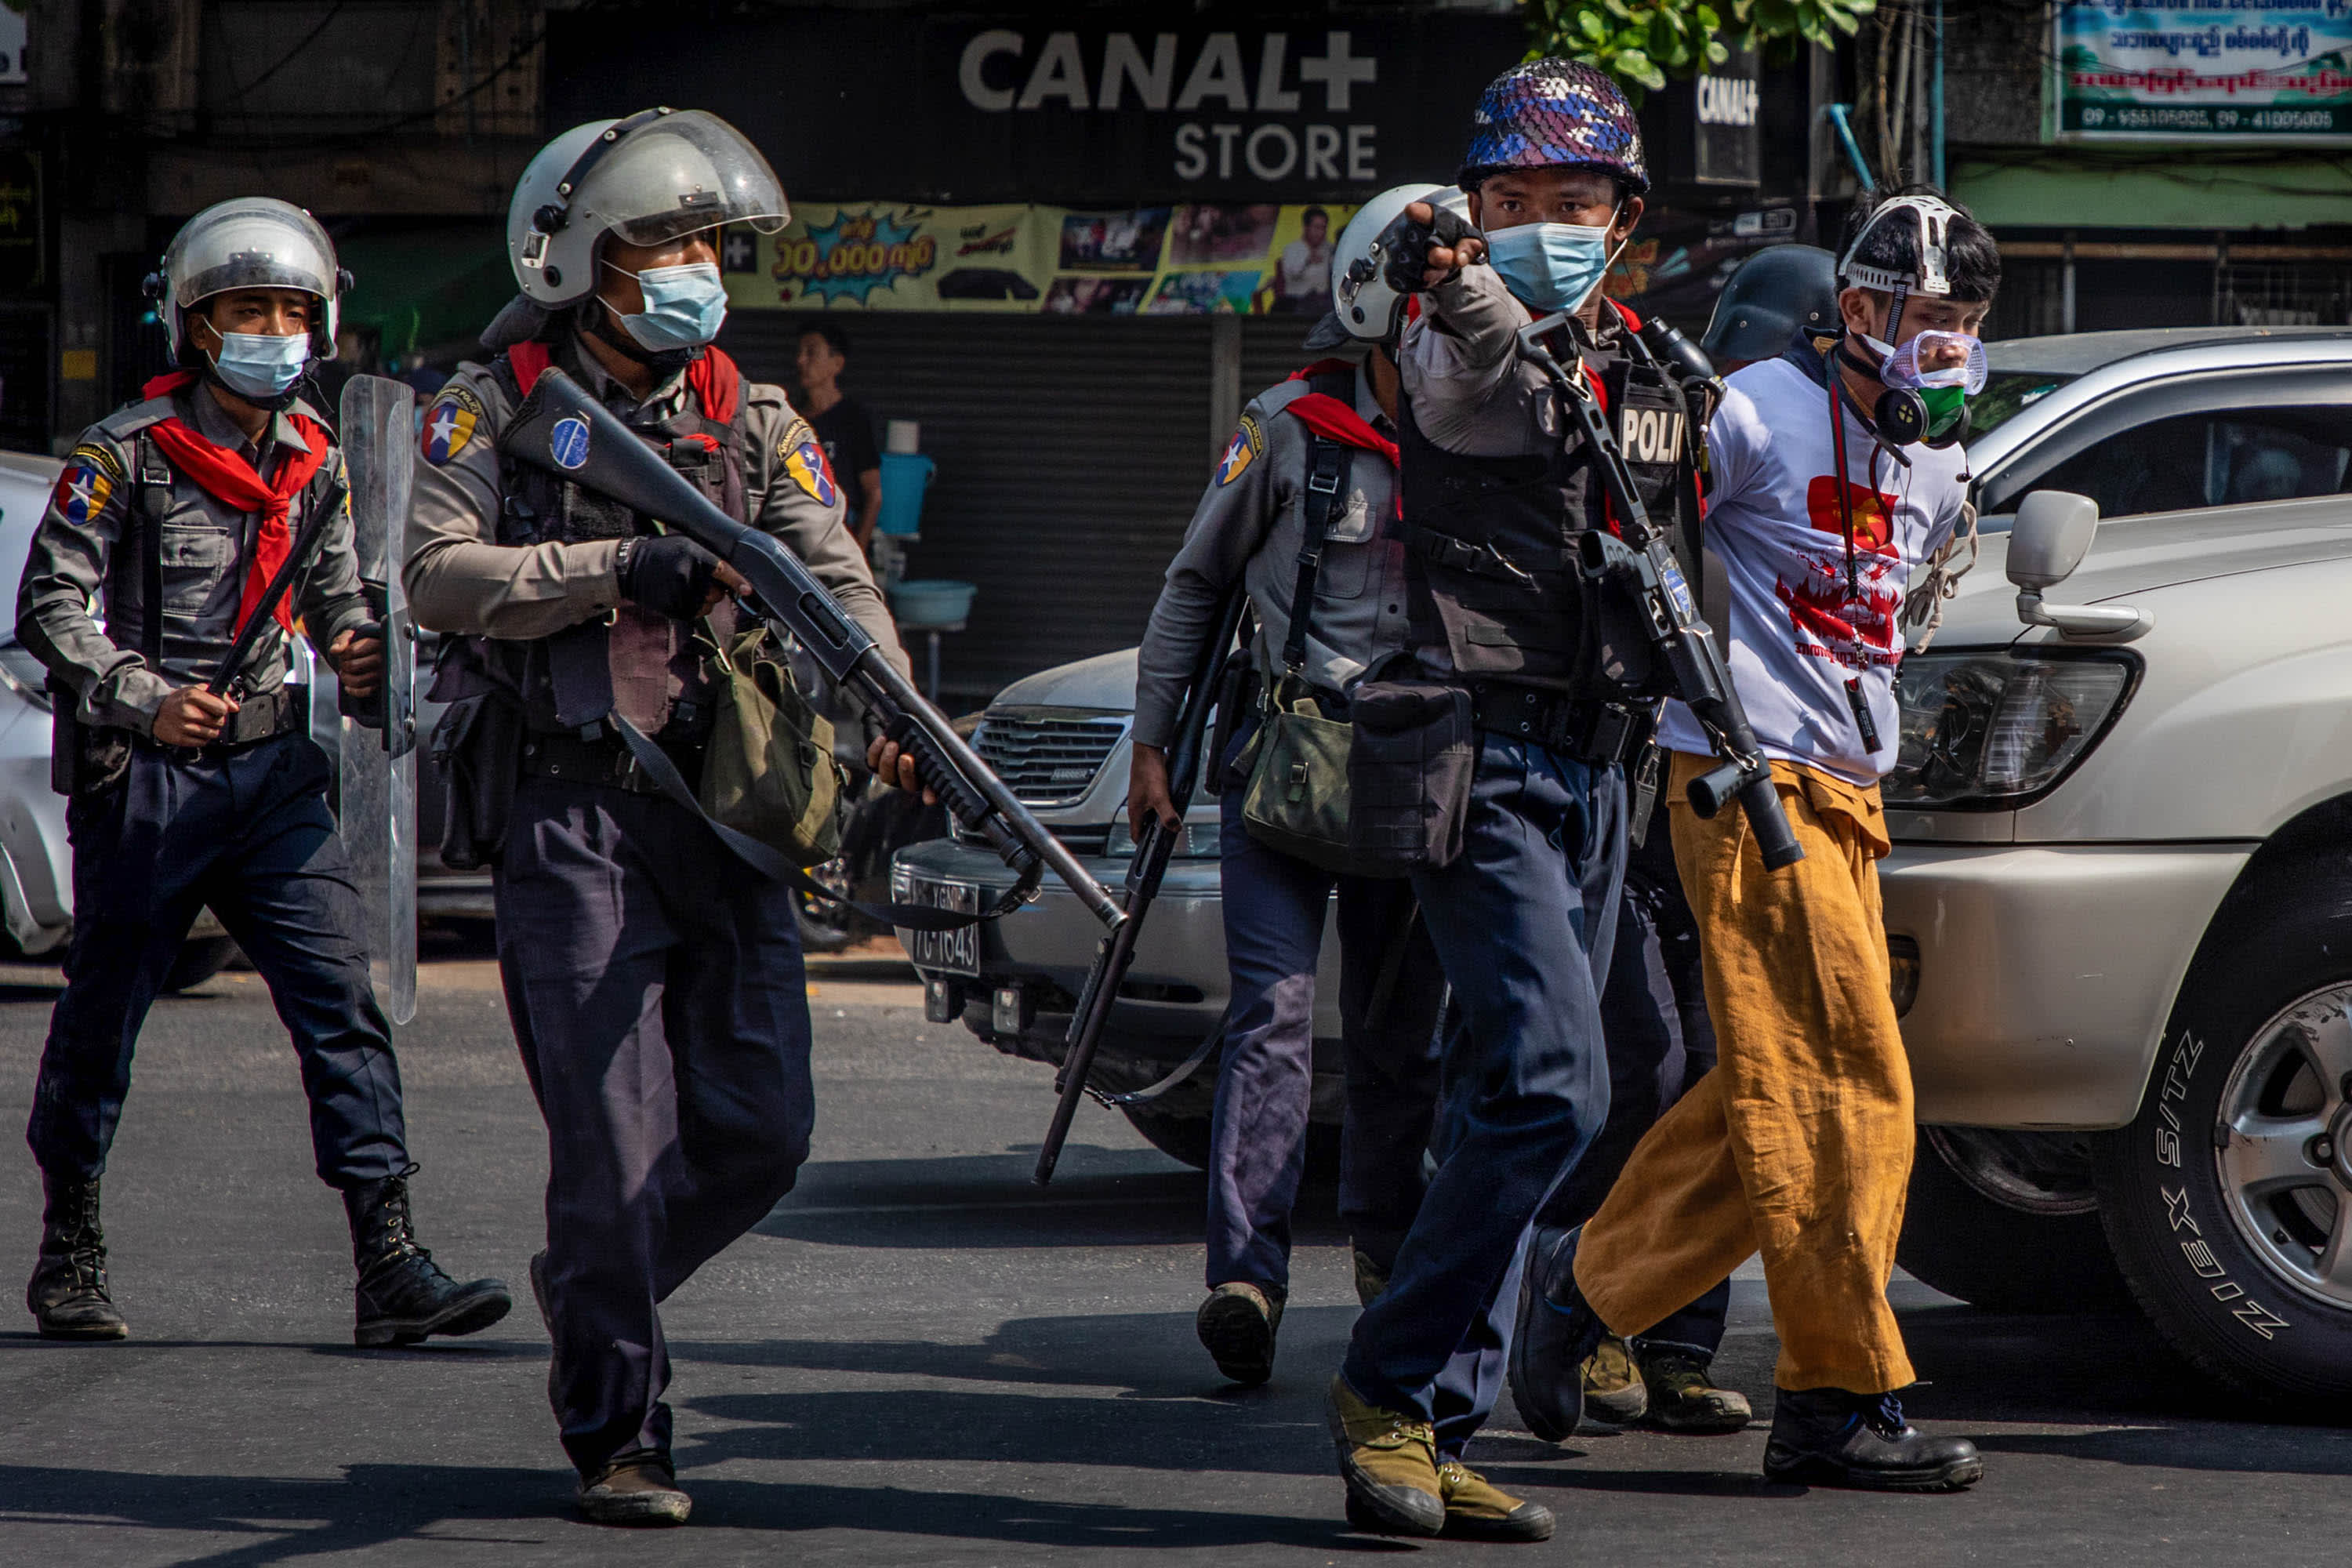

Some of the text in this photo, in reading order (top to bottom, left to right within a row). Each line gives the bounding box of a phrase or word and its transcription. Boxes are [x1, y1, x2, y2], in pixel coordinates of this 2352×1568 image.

[959, 30, 1377, 112] CANAL+
[1697, 74, 1759, 125] CANAL+
[1174, 124, 1377, 180] STORE
[933, 885, 953, 909] YGN
[2155, 1029, 2204, 1168] S/TZ
